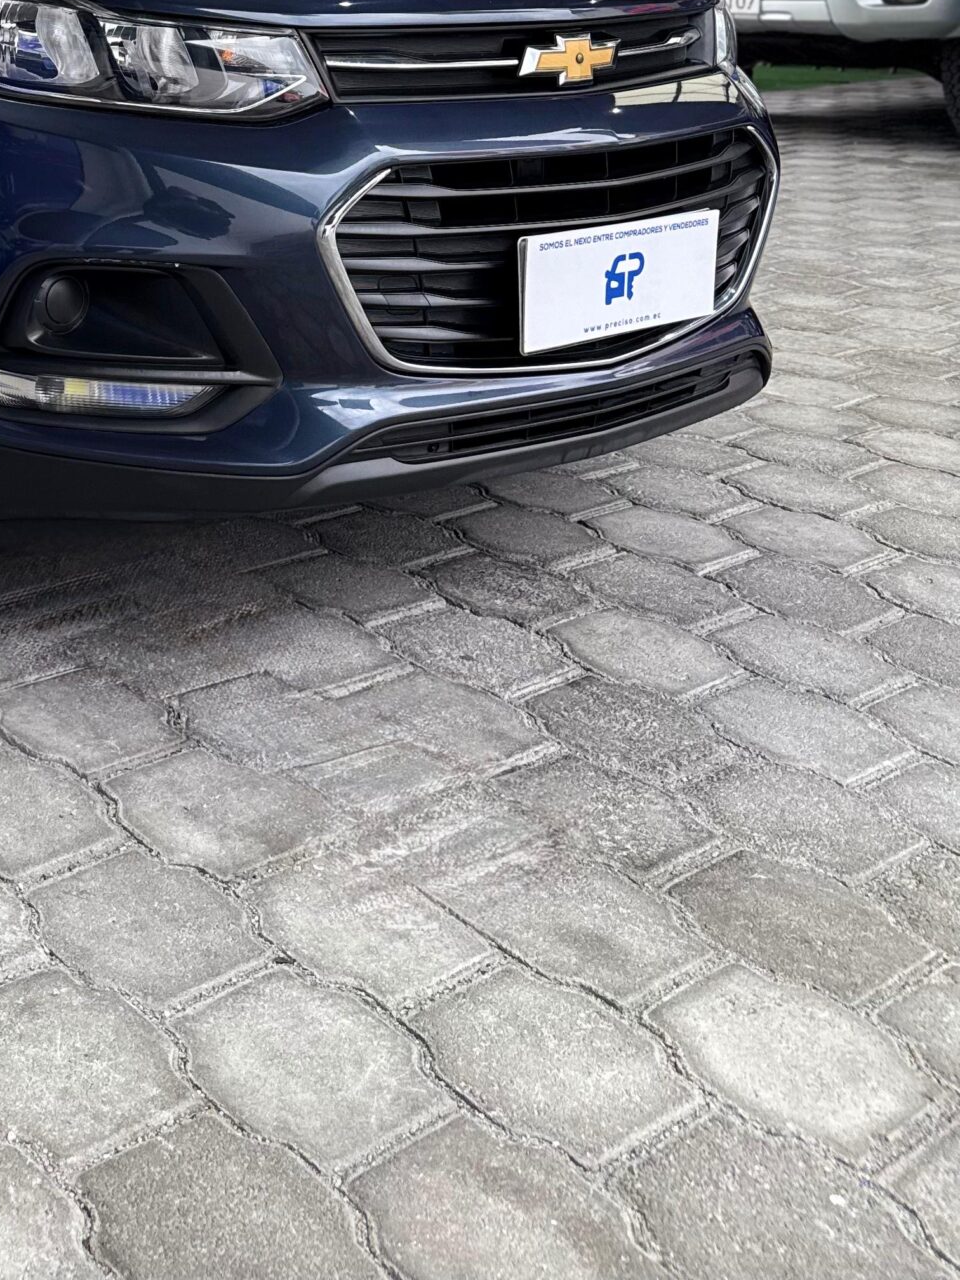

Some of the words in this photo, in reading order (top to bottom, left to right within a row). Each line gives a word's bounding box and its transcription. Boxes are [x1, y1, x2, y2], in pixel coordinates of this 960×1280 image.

[539, 240, 564, 252] SOMOS
[565, 239, 573, 248] EL
[574, 235, 592, 246] NEXO
[593, 232, 614, 243] ENTRE
[614, 225, 663, 240] COMPRADORES
[664, 224, 669, 232] Y
[669, 218, 709, 232] VENDEDORES
